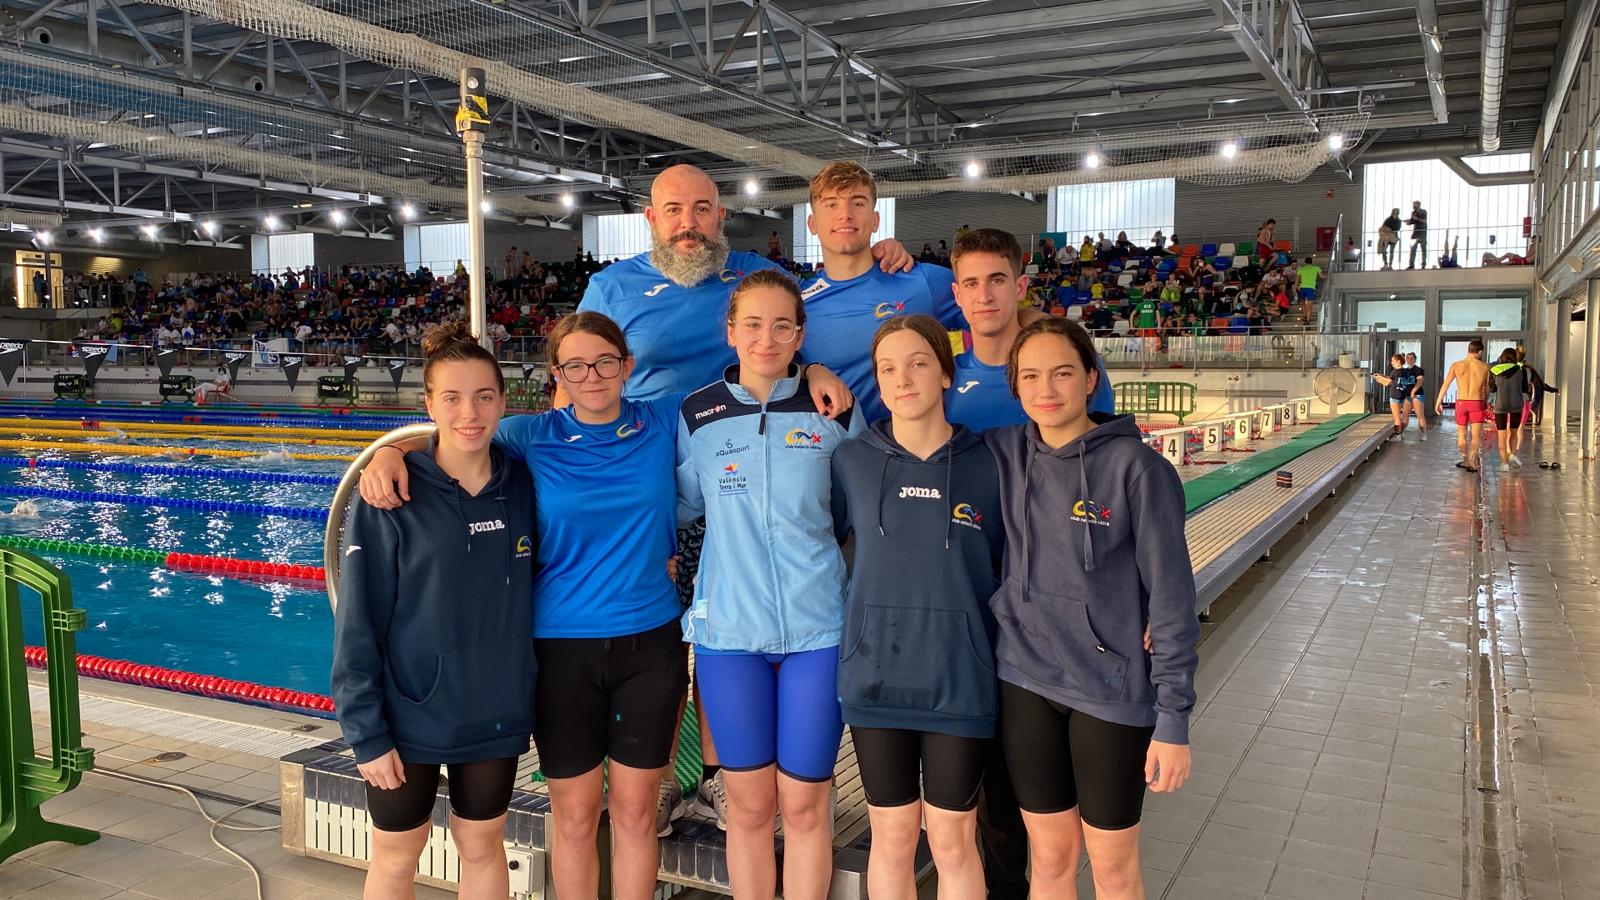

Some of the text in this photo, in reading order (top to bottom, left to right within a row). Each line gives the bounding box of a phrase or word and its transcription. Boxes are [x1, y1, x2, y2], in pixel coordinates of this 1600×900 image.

[0, 342, 24, 350] peedo
[81, 346, 108, 354] speedo
[694, 404, 727, 420] macron
[1284, 408, 1290, 419] 8
[1300, 404, 1306, 414] 9
[1263, 413, 1270, 426] 7
[1239, 420, 1247, 434] 6
[1208, 428, 1217, 444] 5
[1168, 438, 1178, 457] 4
